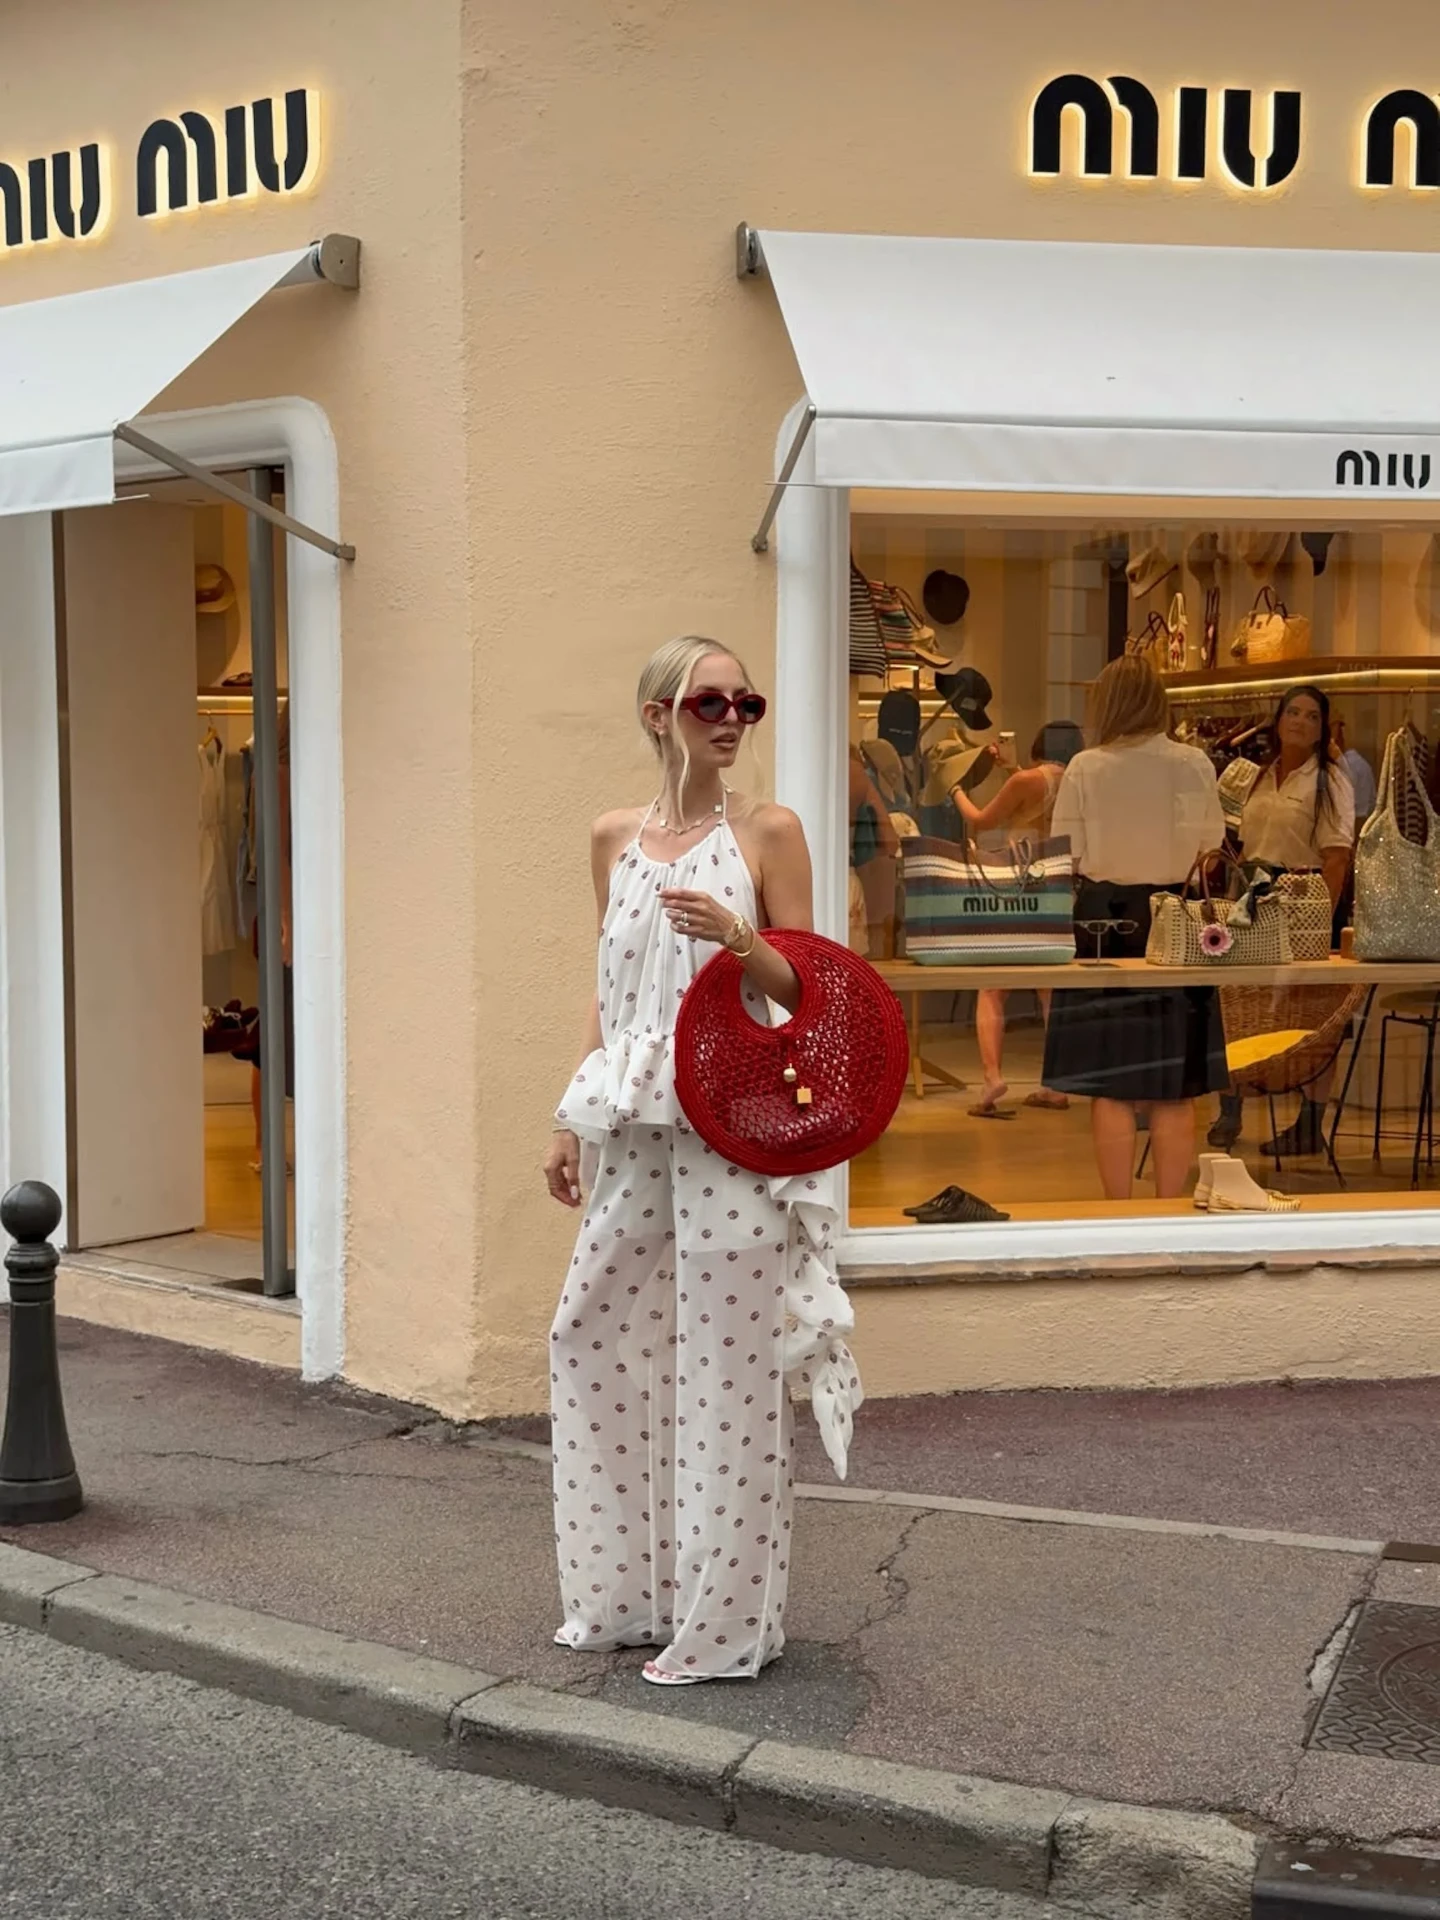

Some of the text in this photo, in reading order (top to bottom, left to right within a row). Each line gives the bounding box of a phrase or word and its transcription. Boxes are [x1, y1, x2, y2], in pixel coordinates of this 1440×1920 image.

[137, 88, 309, 217] MIU
[1032, 73, 1302, 188] MIU
[1336, 449, 1431, 489] MIU
[963, 896, 1038, 912] MIU MIU
